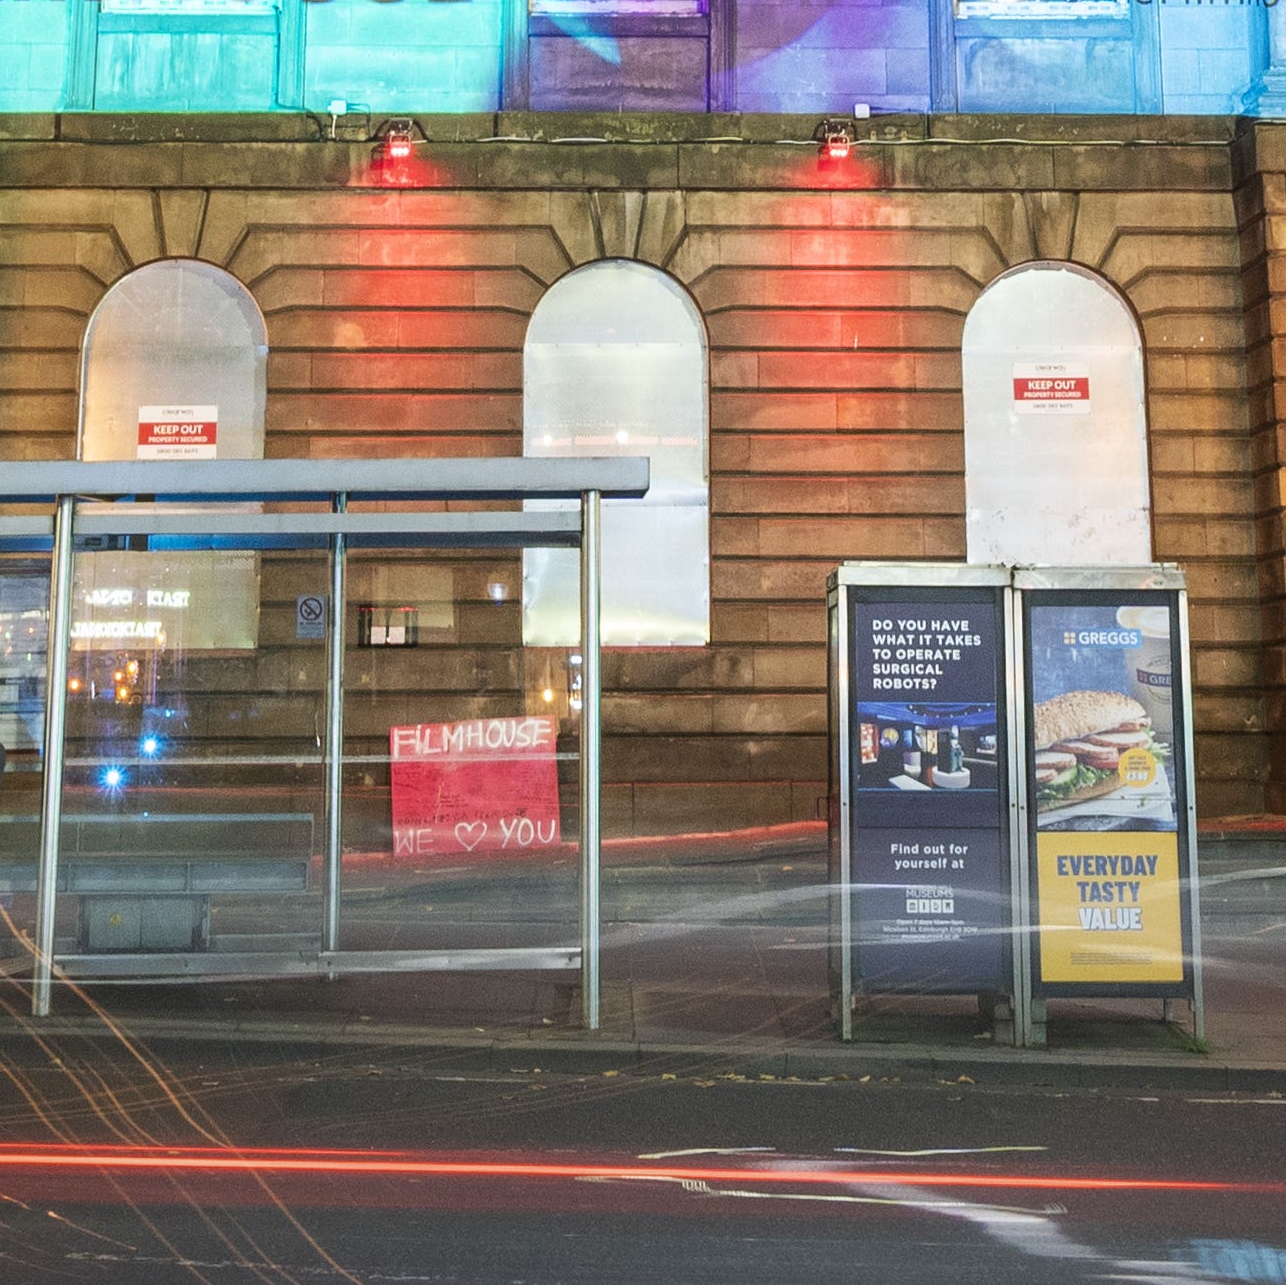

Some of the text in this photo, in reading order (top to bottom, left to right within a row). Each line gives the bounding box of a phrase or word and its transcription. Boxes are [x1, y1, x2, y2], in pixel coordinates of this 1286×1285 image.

[1027, 380, 1076, 390] KEEP OUT
[153, 424, 204, 435] KEEP OUT
[872, 619, 970, 631] DO YOU HAVE
[872, 634, 982, 646] WHAT IT TAKES
[1078, 631, 1139, 645] GREGGS
[872, 649, 961, 660] TO OPERATE
[872, 663, 943, 675] SURGICAL
[873, 678, 937, 690] ROBOTS?
[394, 827, 435, 854] WE
[499, 817, 556, 849] YOU
[890, 843, 969, 854] Find out for
[895, 857, 965, 870] yourself at
[1057, 855, 1158, 876] EVERYDAY
[906, 887, 954, 899] MUSEUMS
[1076, 881, 1141, 902] TASTY
[1078, 907, 1143, 931] VALUE
